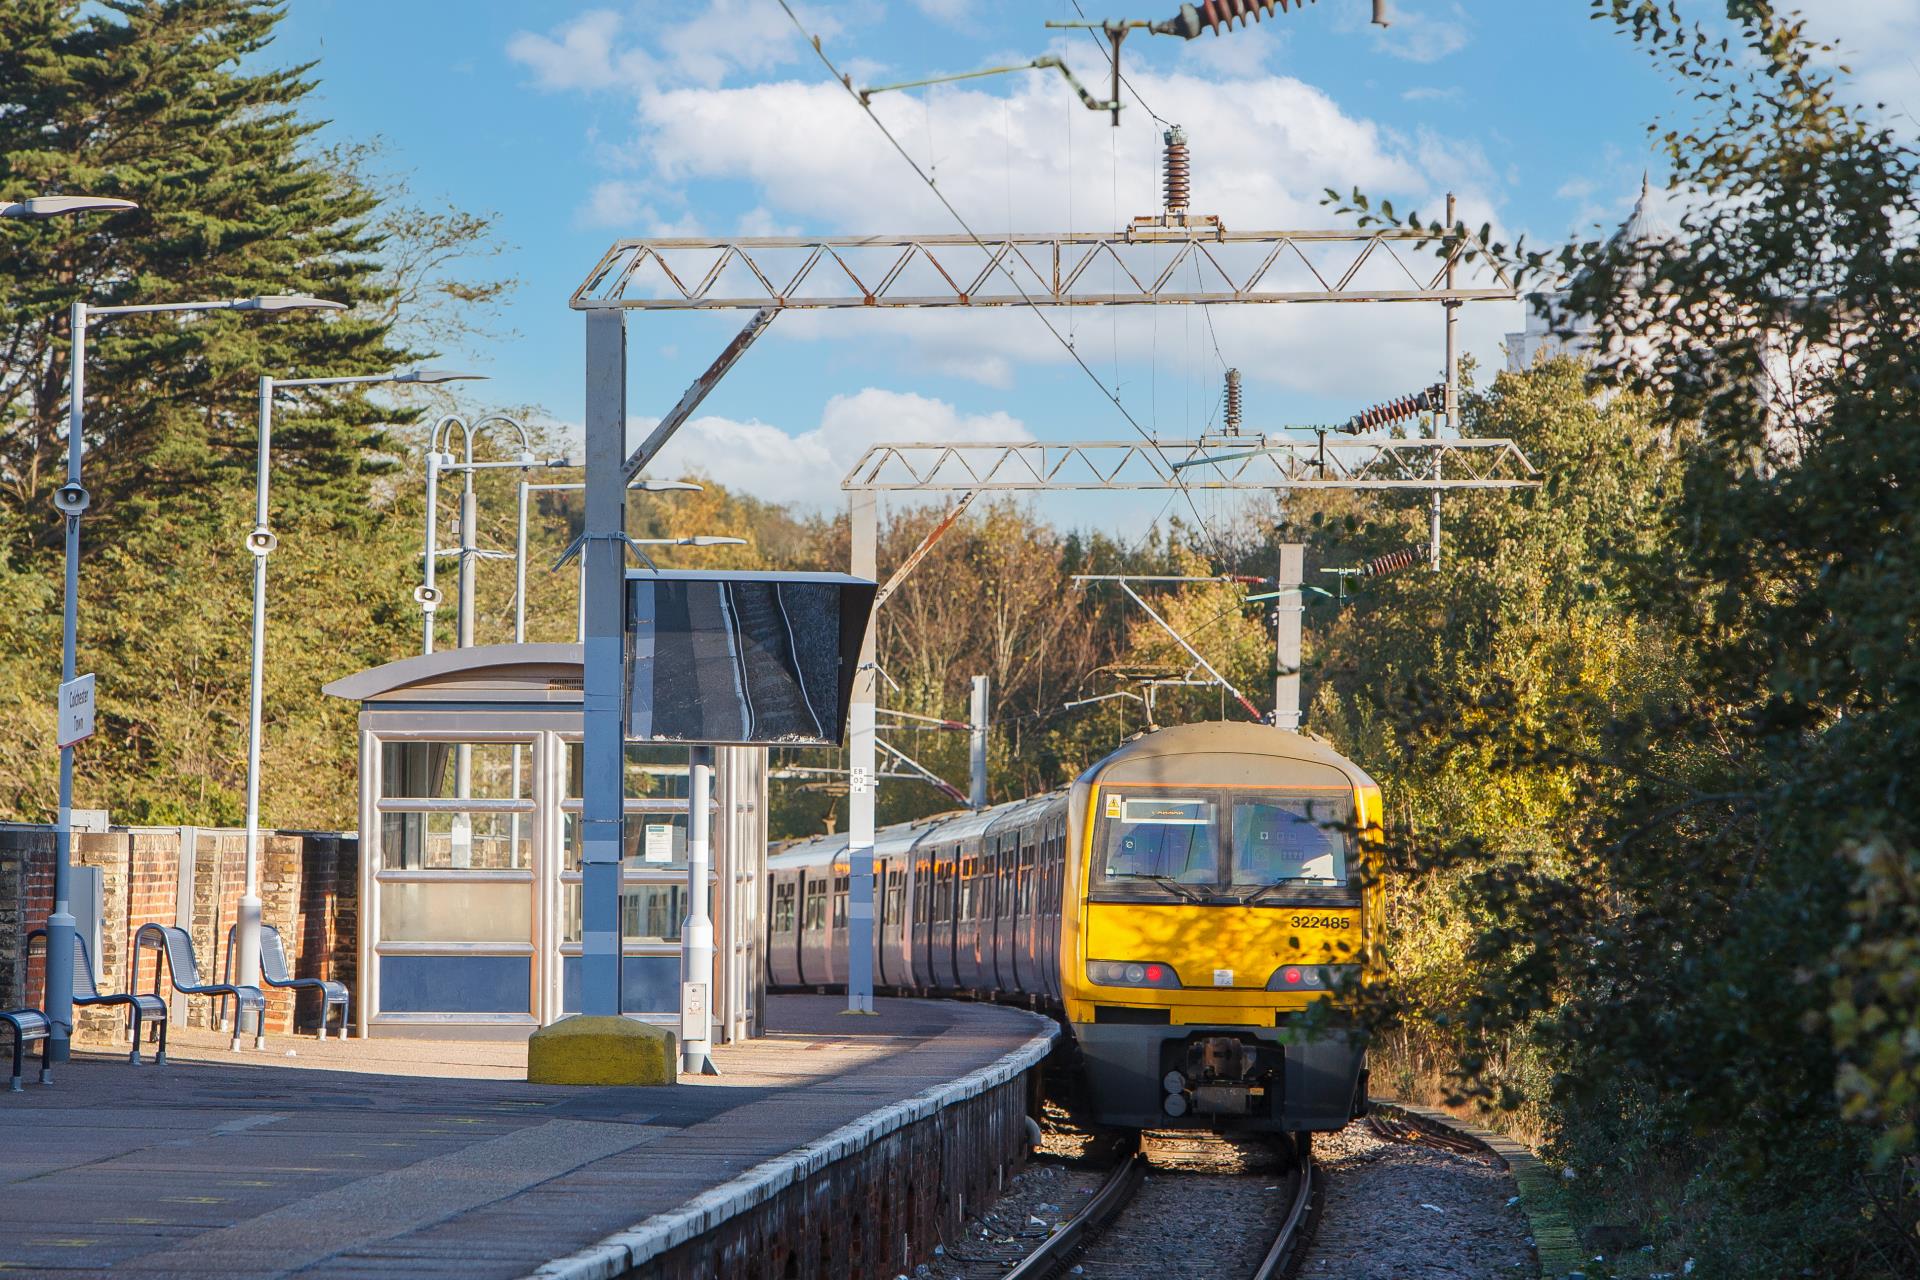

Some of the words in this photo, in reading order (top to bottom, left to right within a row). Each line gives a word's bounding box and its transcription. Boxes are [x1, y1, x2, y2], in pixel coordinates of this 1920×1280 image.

[69, 688, 89, 708] Colchester
[73, 715, 84, 732] Town
[1291, 915, 1350, 929] 322485
